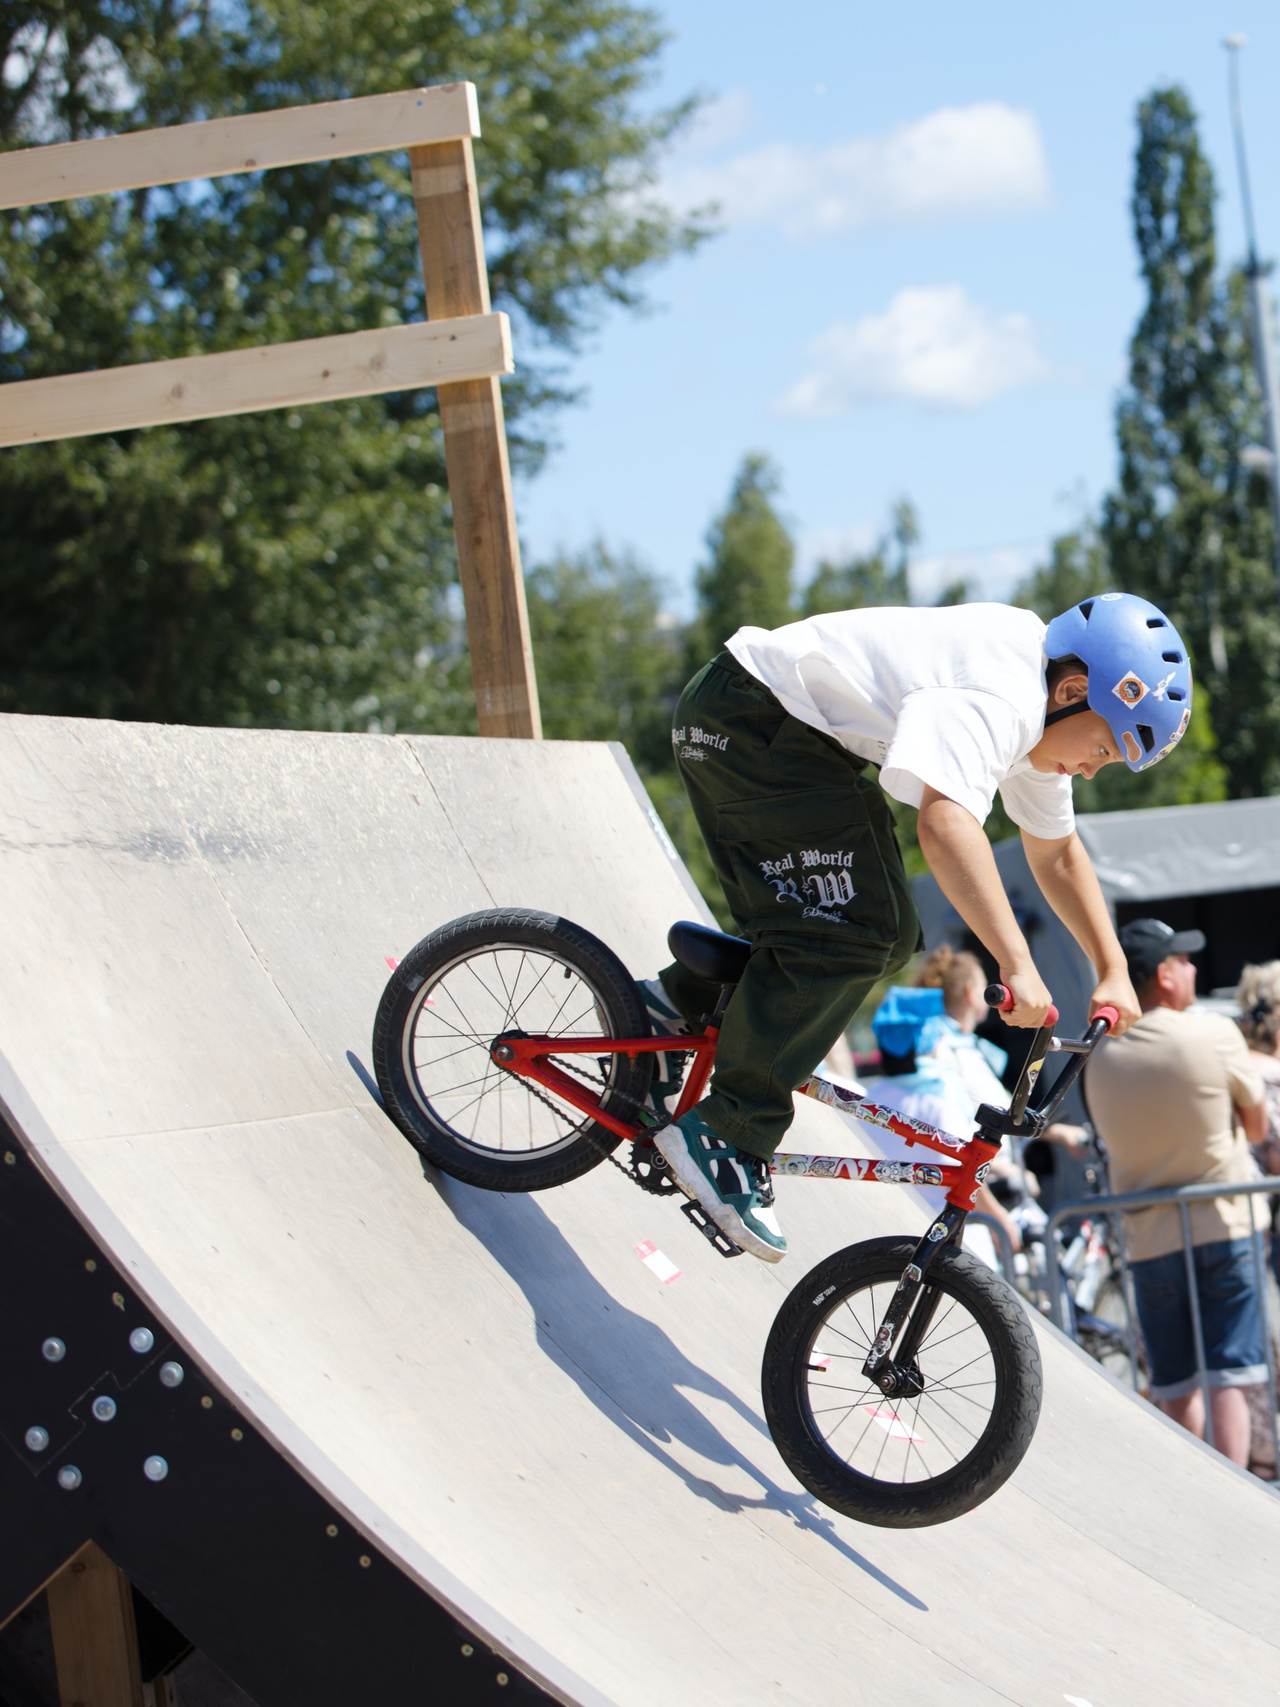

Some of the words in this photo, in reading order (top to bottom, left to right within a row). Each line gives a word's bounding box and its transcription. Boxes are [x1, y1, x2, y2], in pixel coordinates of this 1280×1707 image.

[690, 726, 730, 751] World
[759, 852, 796, 880] Real
[800, 849, 854, 870] World
